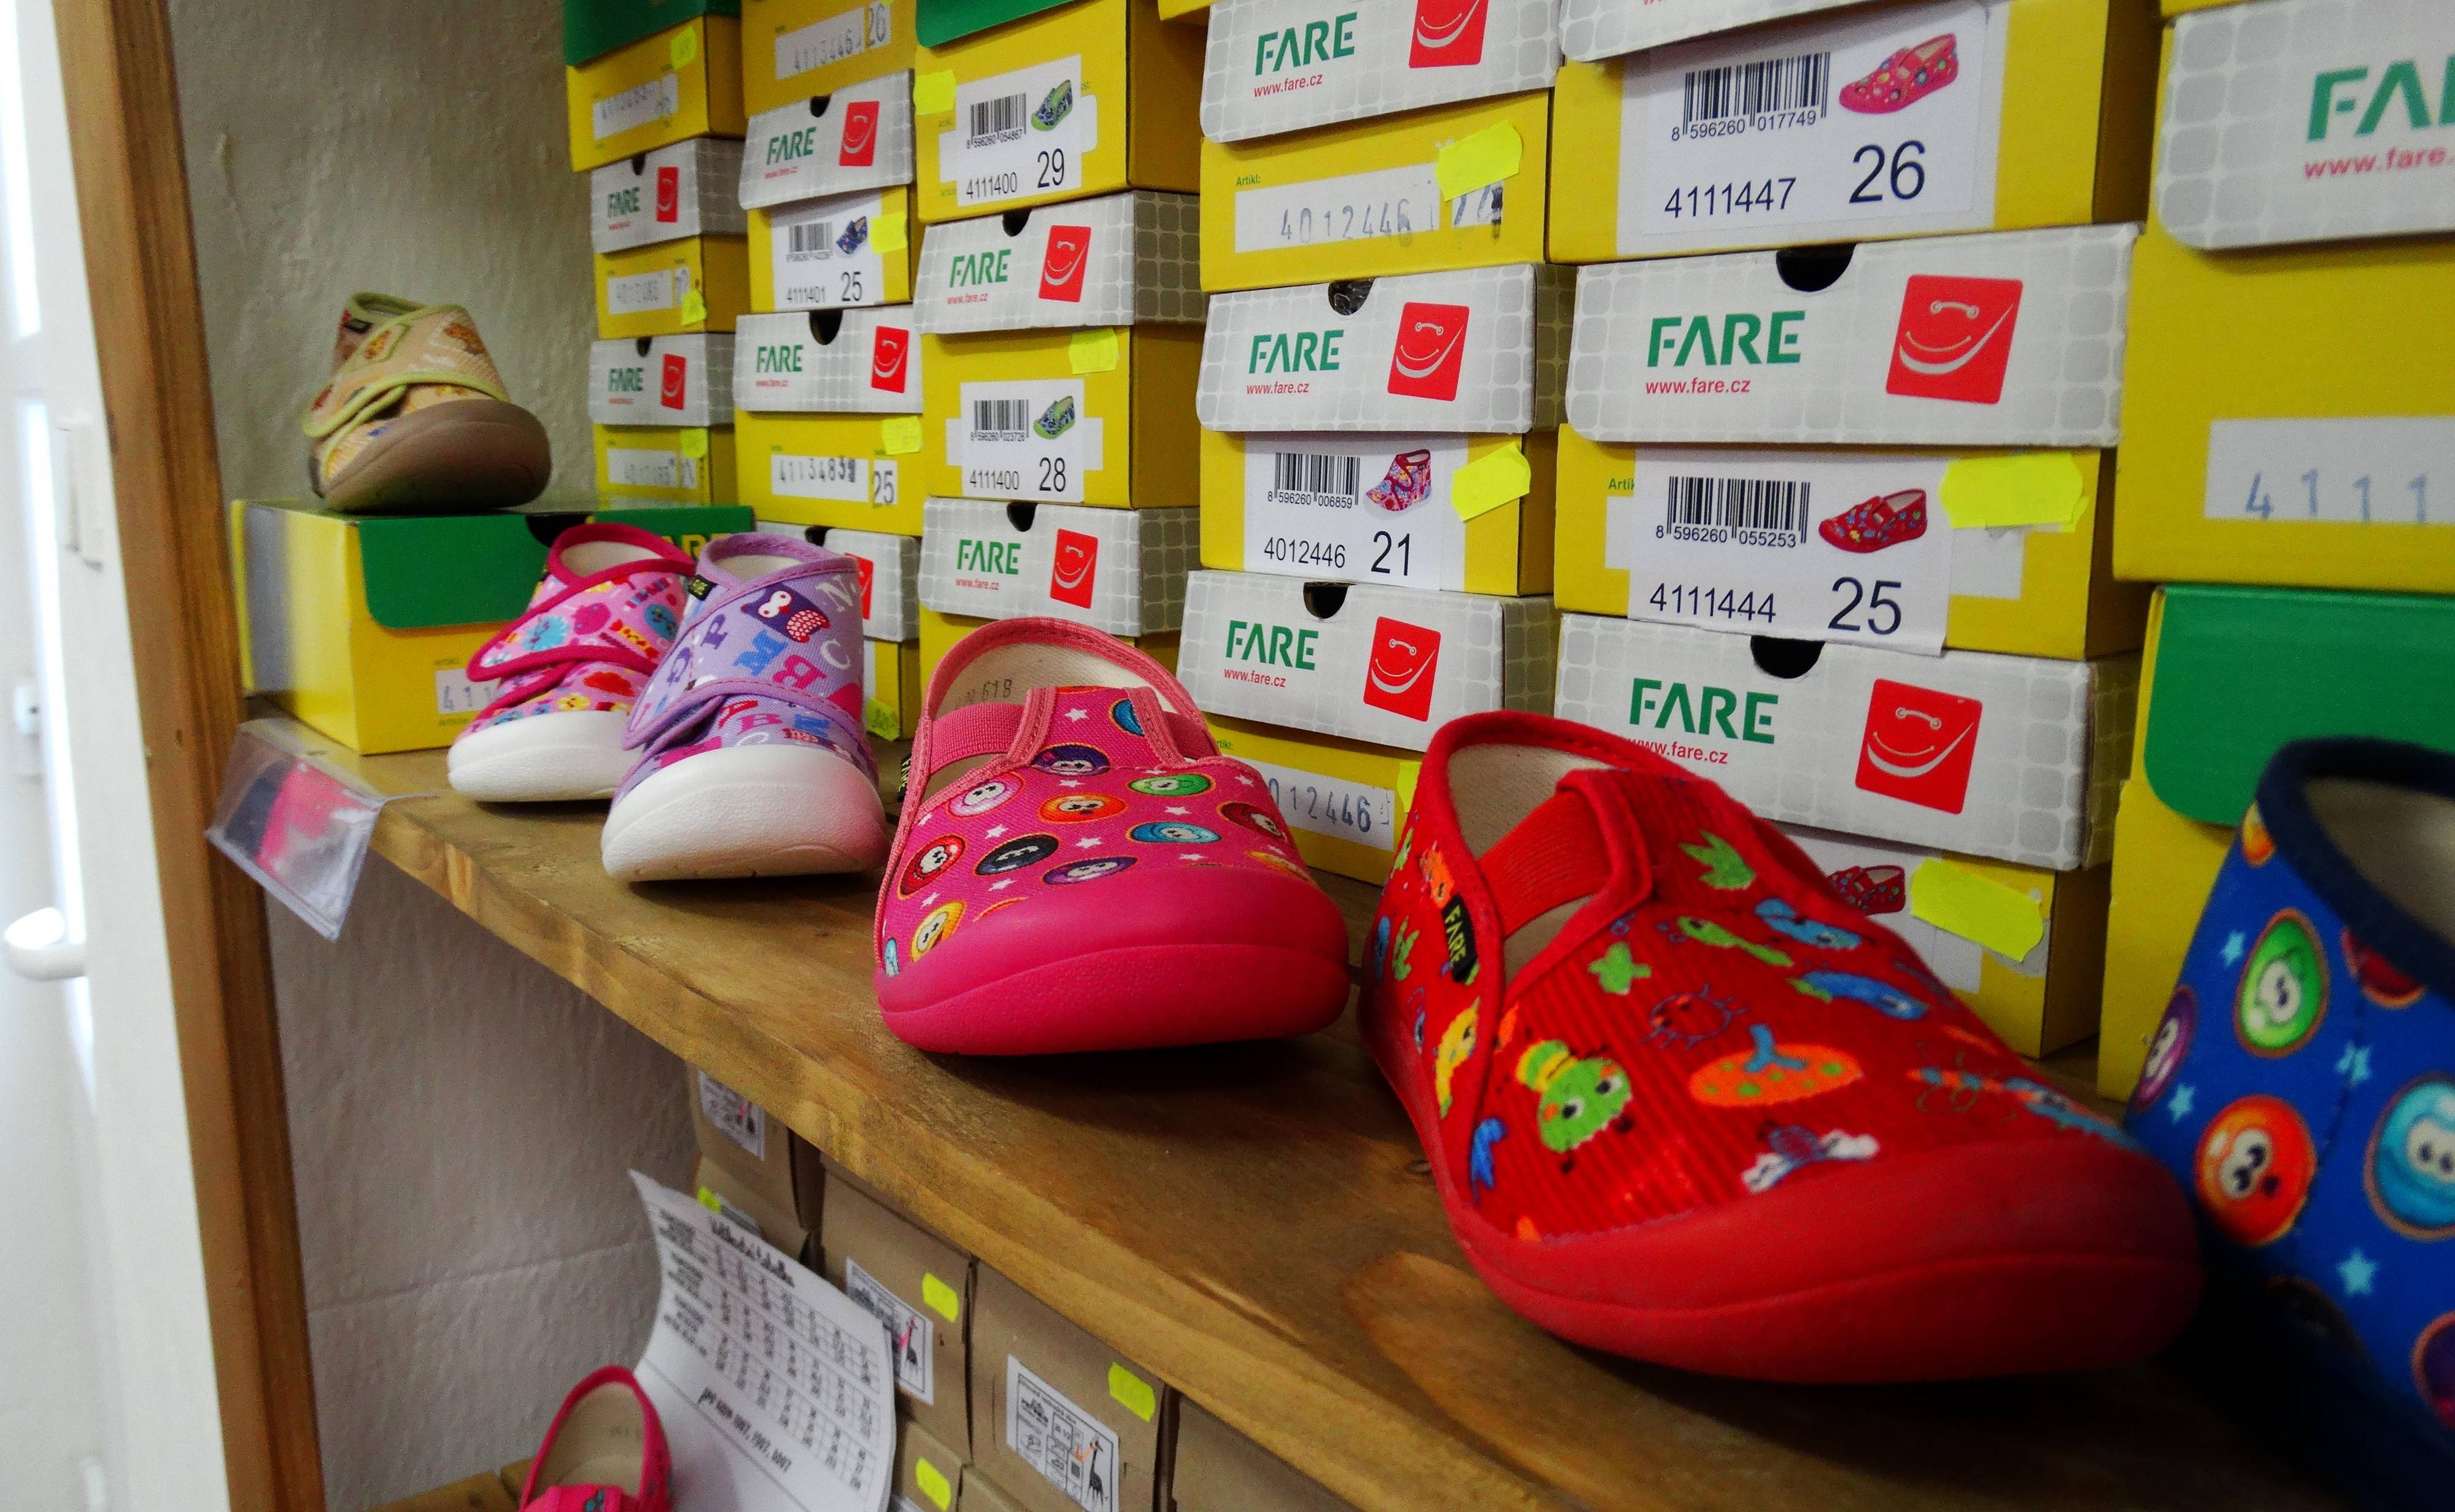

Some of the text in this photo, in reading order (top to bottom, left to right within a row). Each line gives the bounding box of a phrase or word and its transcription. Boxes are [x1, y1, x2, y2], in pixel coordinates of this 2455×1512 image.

[1255, 11, 1358, 76] FARE
[1253, 73, 1323, 98] www.fare.cz
[2306, 52, 2455, 142] FA
[767, 125, 817, 165] FARE
[1671, 110, 1817, 141] 8 596260 017749
[965, 172, 1018, 199] 4111400
[1037, 148, 1065, 188] 29
[1848, 140, 1926, 204] 26
[1664, 177, 1797, 218] 4111447
[840, 271, 863, 301] 25
[949, 248, 1012, 288] FARE
[756, 344, 803, 372] FARE
[1248, 329, 1344, 374] FARE
[1646, 309, 1806, 368] FARE
[1246, 380, 1310, 395] www.fare.cz
[1645, 377, 1751, 396] www.fare.cz
[872, 470, 895, 504] 25
[970, 469, 1020, 490] 4111400
[1039, 457, 1067, 492] 28
[2244, 466, 2428, 523] 4111
[1267, 491, 1353, 509] 8 596260 006859
[957, 539, 1021, 575] FARE
[1264, 536, 1346, 568] 4012446
[1371, 530, 1410, 576] 21
[1655, 525, 1796, 549] 8 596260 055253
[1649, 582, 1776, 623] 4111444
[1827, 576, 1903, 635] 25
[1225, 619, 1319, 671] FARE
[1223, 668, 1286, 688] www.fare.cz
[1628, 677, 1779, 745] FARE
[1444, 904, 1467, 964] FARE
